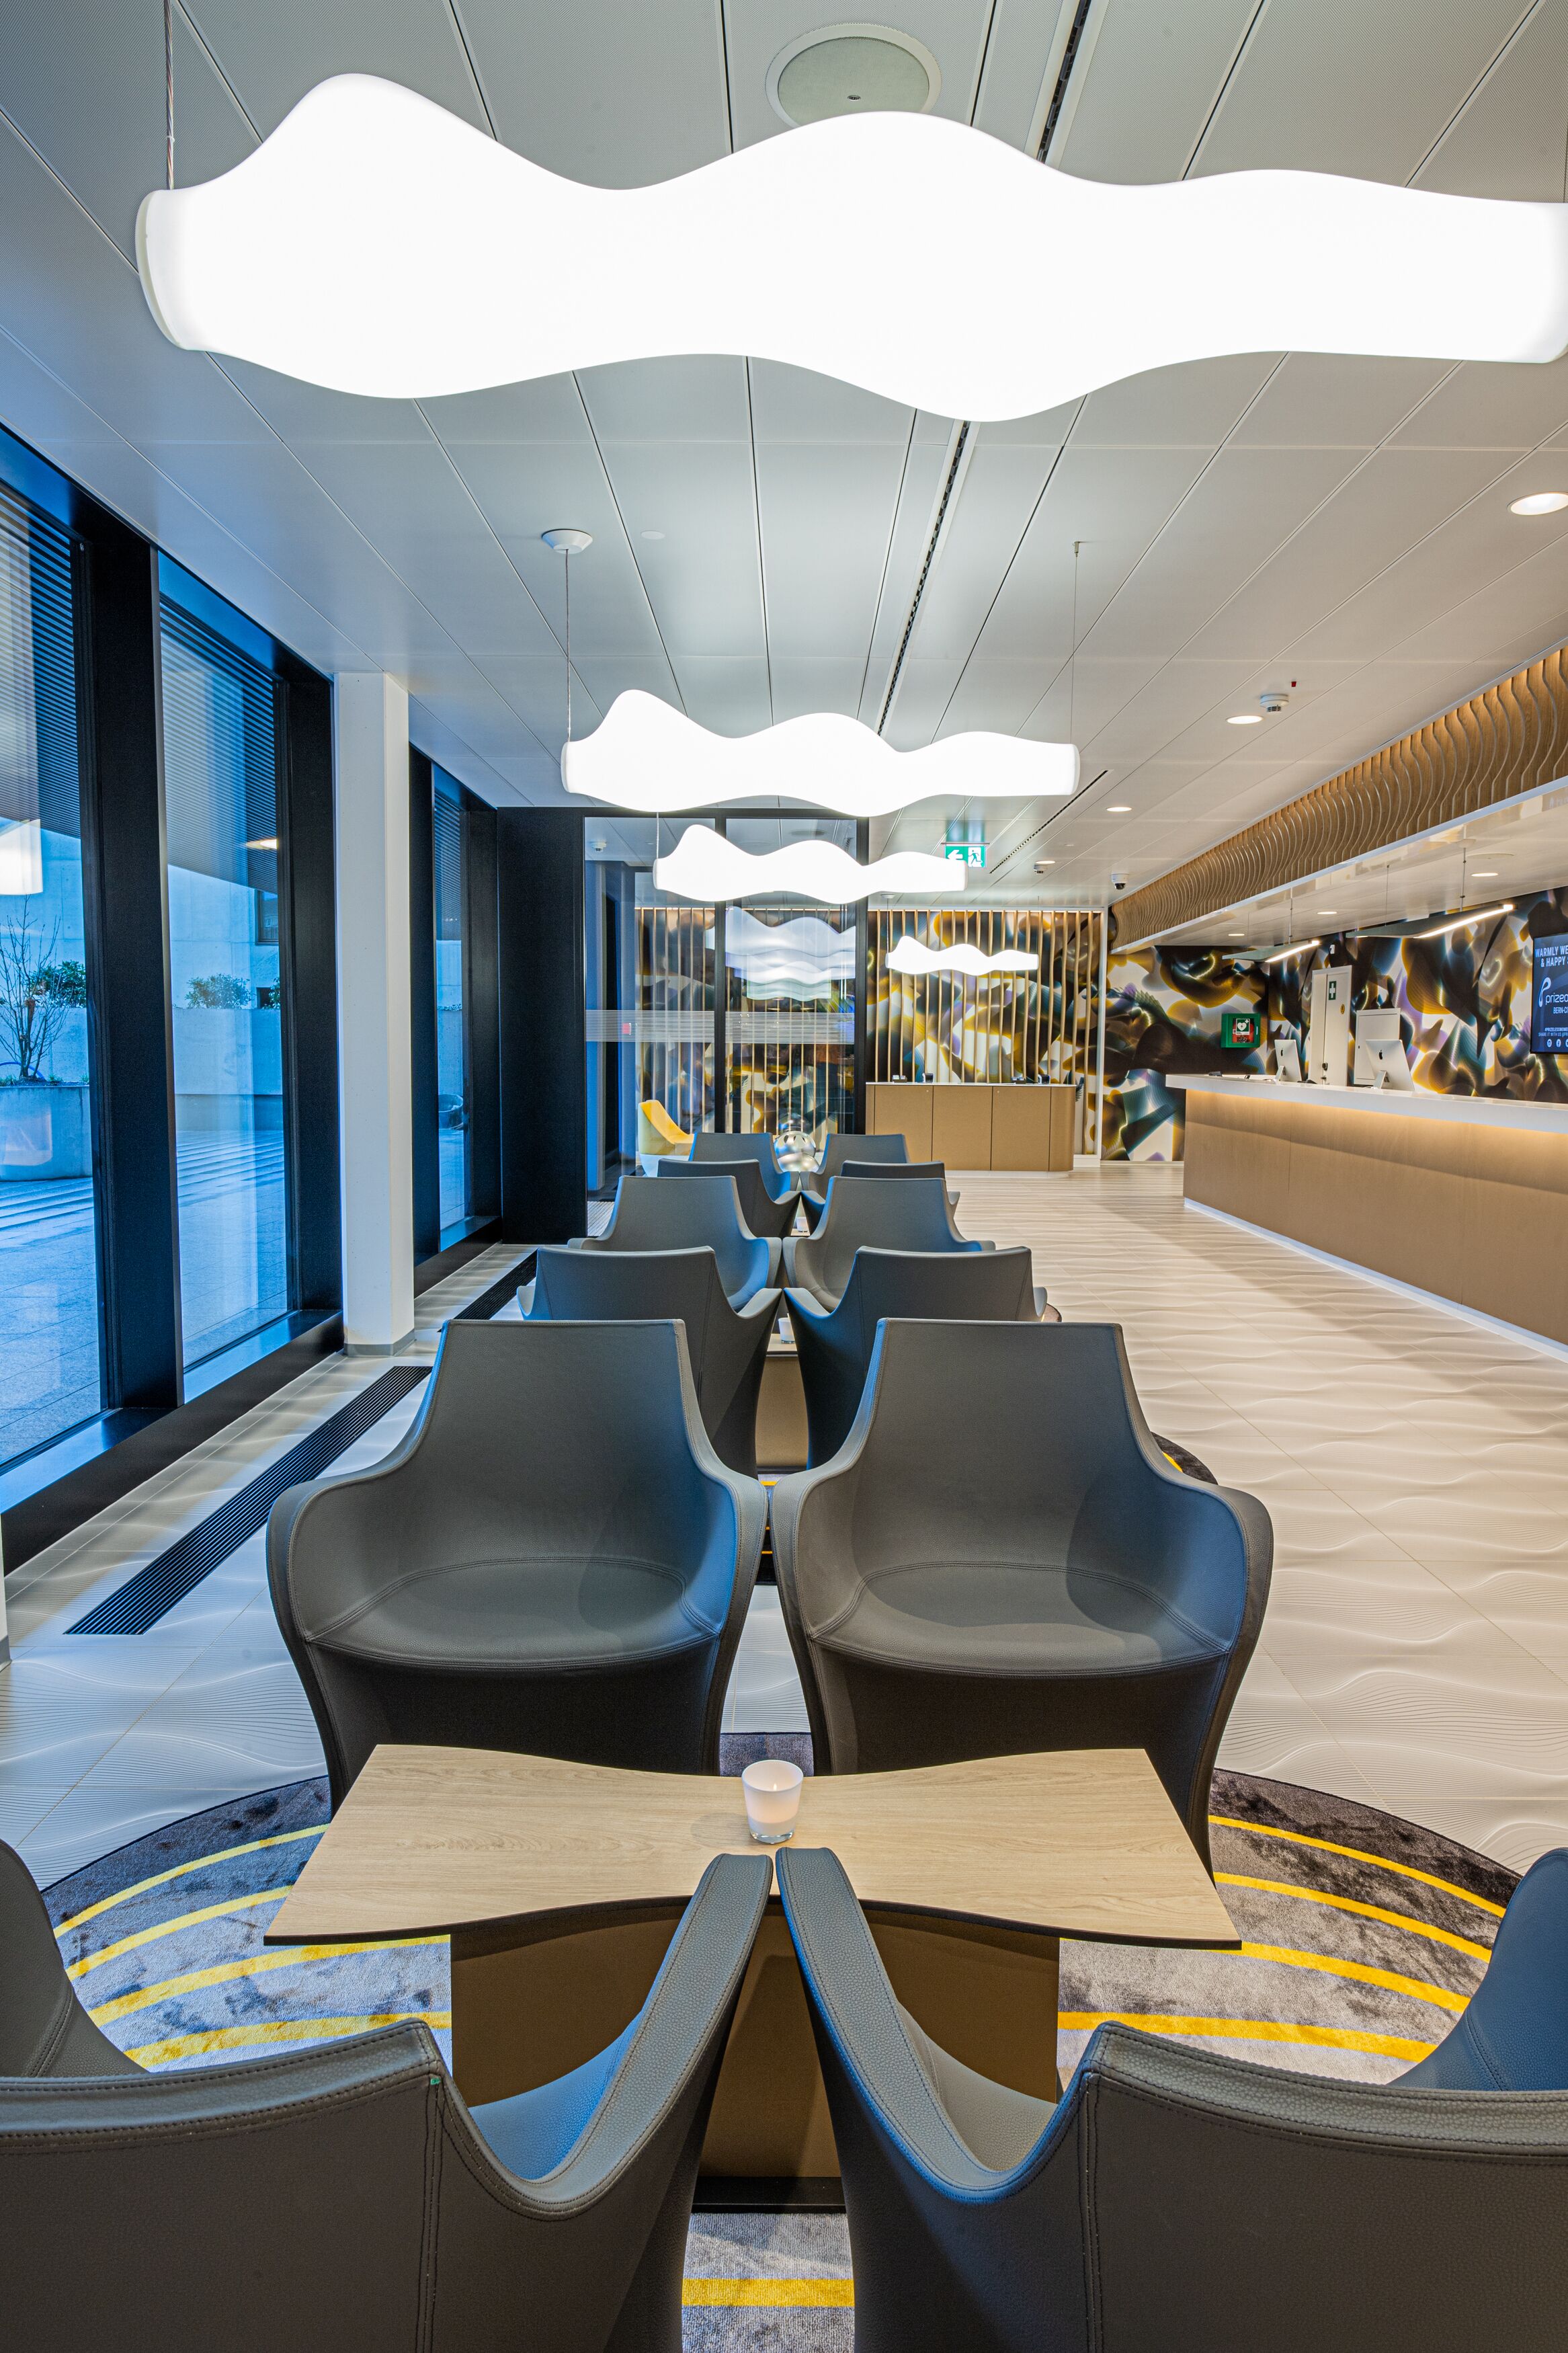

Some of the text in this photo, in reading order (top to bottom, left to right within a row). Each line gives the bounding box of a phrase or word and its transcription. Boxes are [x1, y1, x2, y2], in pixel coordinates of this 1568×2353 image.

[1535, 946, 1559, 957] WARMLY
[1540, 956, 1566, 967] & HAPPY
